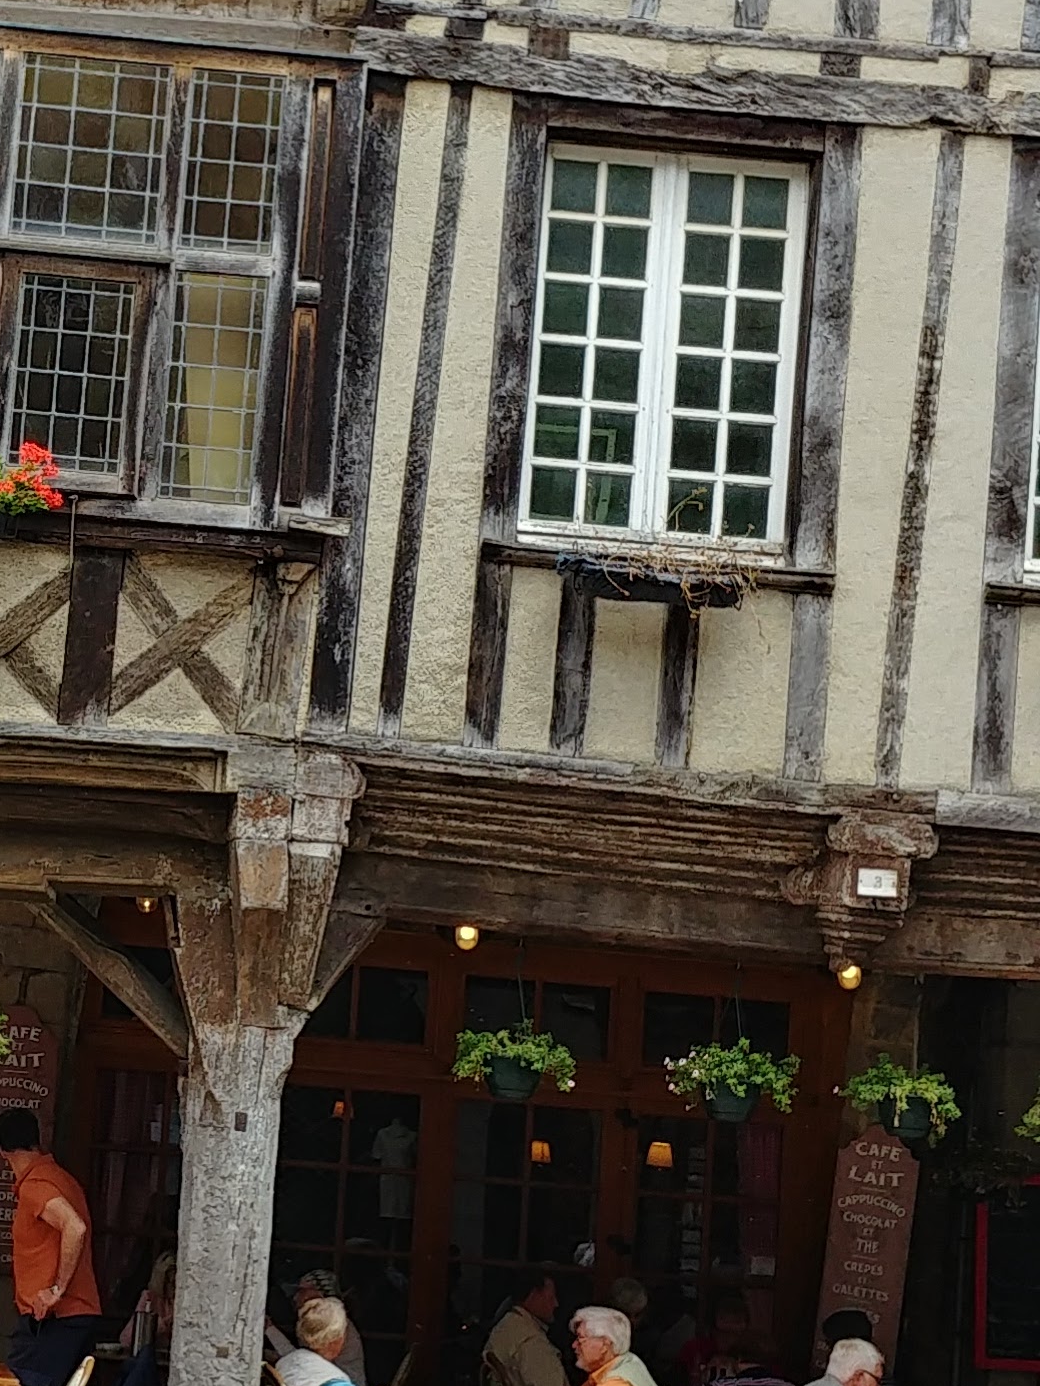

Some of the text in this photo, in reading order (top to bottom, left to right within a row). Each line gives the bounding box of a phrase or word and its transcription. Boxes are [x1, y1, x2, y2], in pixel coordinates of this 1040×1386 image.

[855, 1141, 903, 1163] CAFE
[871, 1160, 884, 1170] ET
[847, 1164, 905, 1187] LAIT
[837, 1194, 906, 1218] CAPPUCCINO
[843, 1211, 898, 1230] CHOCOLAT
[856, 1237, 880, 1253] THE
[844, 1260, 884, 1276] CREPES
[832, 1283, 890, 1302] GALETTES
